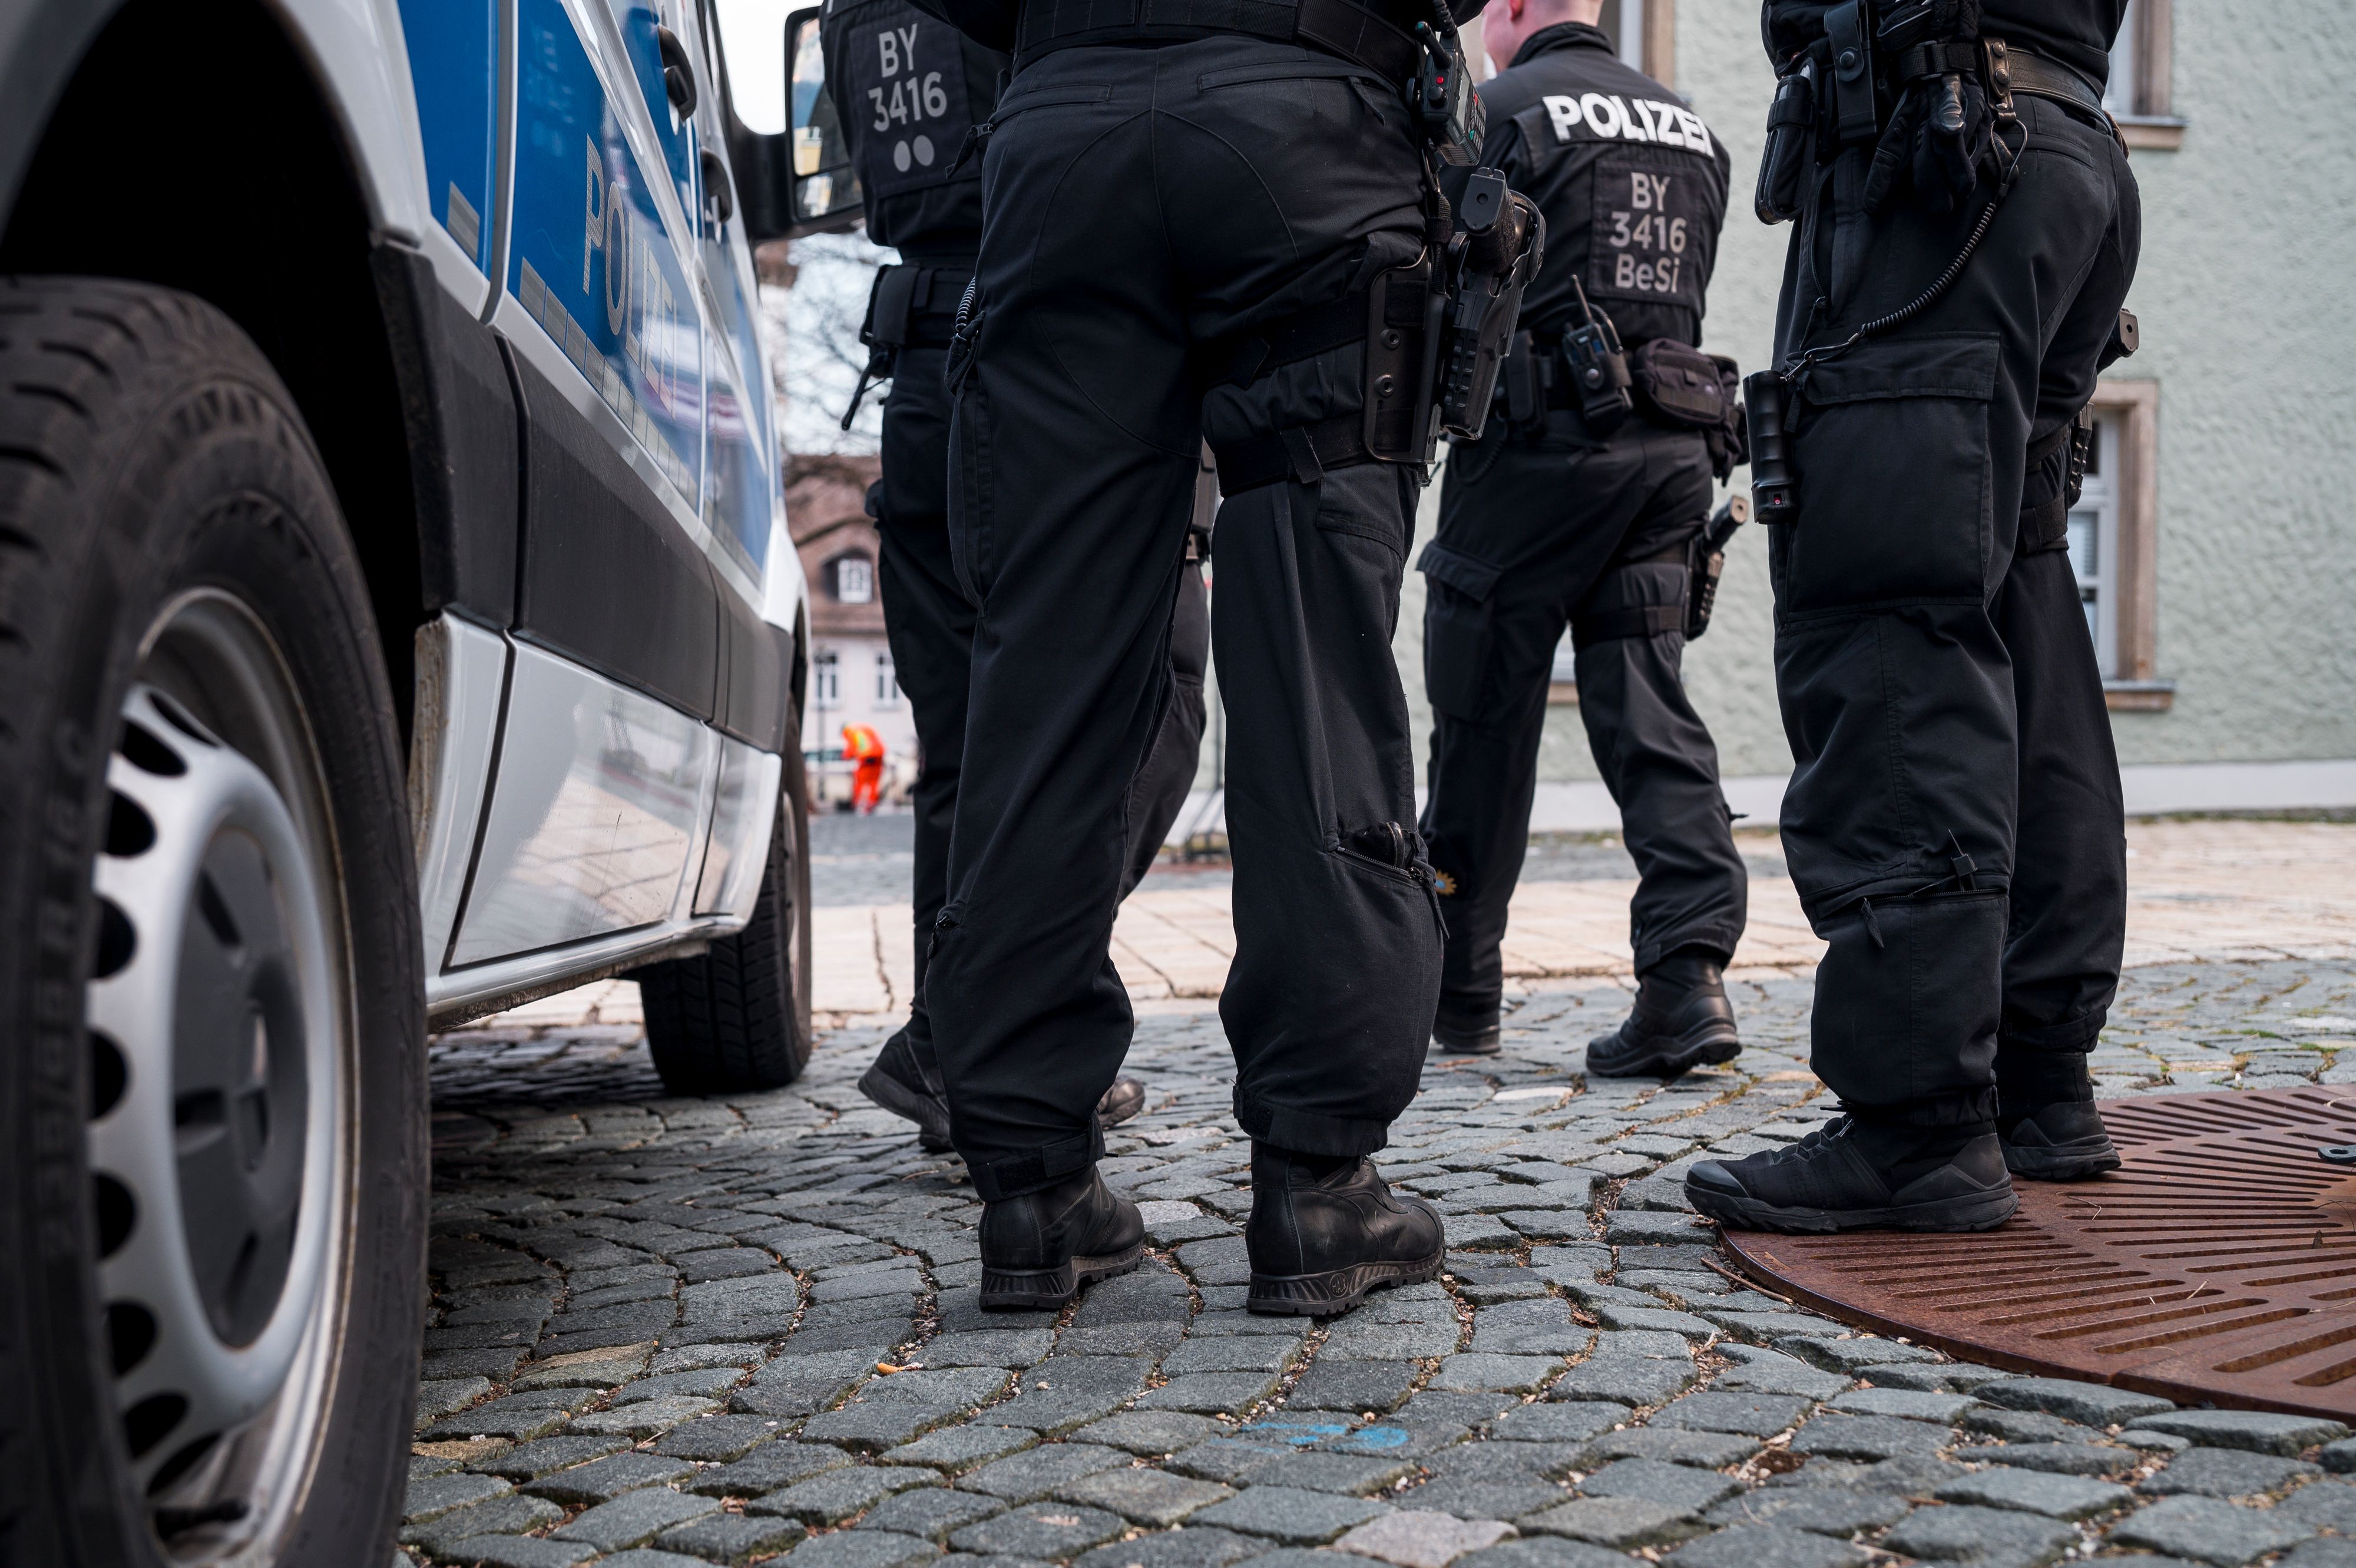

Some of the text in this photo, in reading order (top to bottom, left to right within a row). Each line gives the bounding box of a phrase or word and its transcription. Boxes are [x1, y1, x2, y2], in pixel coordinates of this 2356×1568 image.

[878, 22, 918, 78] BY
[867, 71, 948, 133] 3416
[1542, 92, 1715, 160] POLIZEI
[1630, 171, 1671, 213] BY
[1609, 210, 1687, 255] 3416
[583, 133, 677, 421] POLIZEI
[1614, 253, 1681, 294] BeSi
